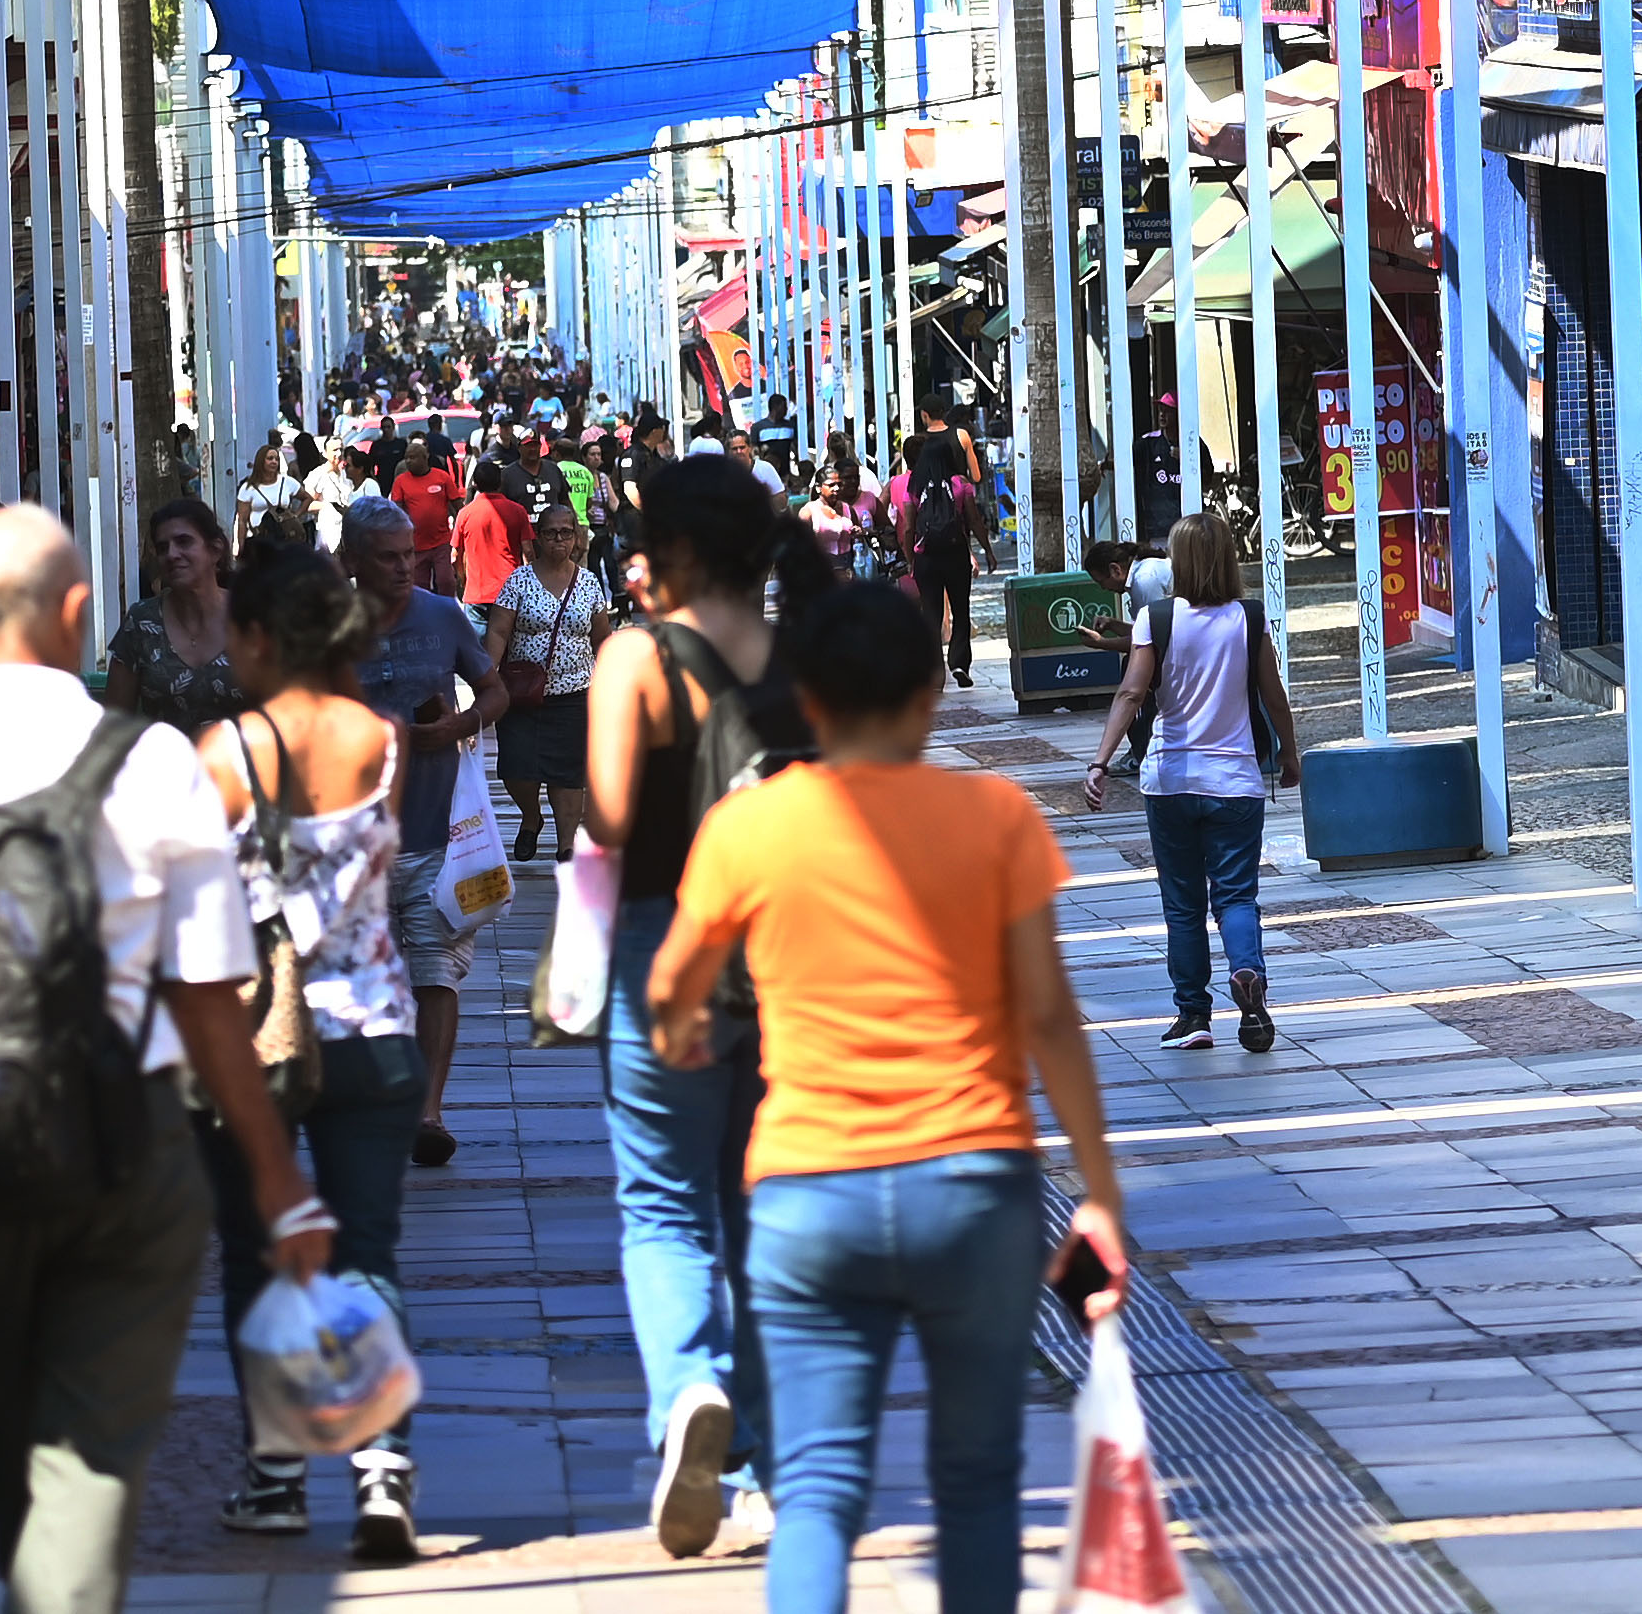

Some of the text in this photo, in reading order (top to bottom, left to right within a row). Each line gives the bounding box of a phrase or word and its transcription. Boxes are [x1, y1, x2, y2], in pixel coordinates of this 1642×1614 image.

[1317, 382, 1405, 415] PRÇO
[1323, 417, 1405, 449] ÚNCO
[1055, 663, 1090, 679] lixo
